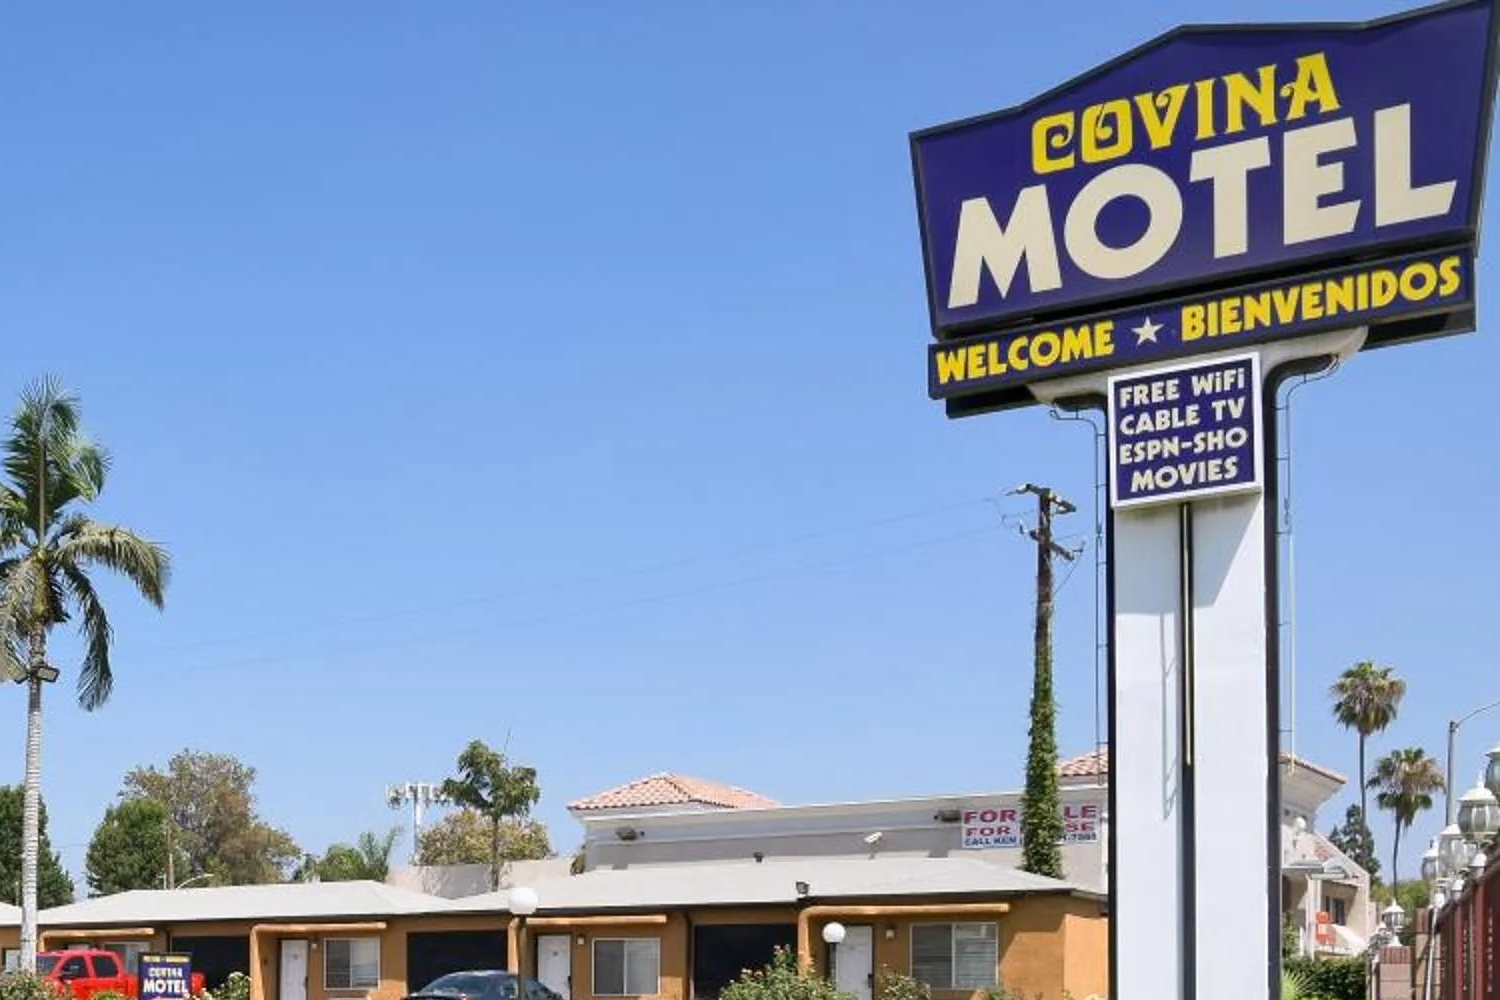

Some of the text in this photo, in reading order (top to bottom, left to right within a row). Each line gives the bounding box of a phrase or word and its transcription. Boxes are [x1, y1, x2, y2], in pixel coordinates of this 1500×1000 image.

[1031, 51, 1341, 175] COVINA
[947, 102, 1458, 309] MOTEL
[936, 256, 1461, 385] WELCOME BIENVENIDOS
[1119, 367, 1246, 409] FREE WiFi
[1119, 396, 1246, 435] CABLE TV
[1119, 426, 1248, 465] ESPN-SHO
[1130, 455, 1239, 493] MOVIES
[963, 809, 1017, 825] FOR
[965, 826, 1012, 837] FOR
[143, 979, 189, 993] MOTEL
